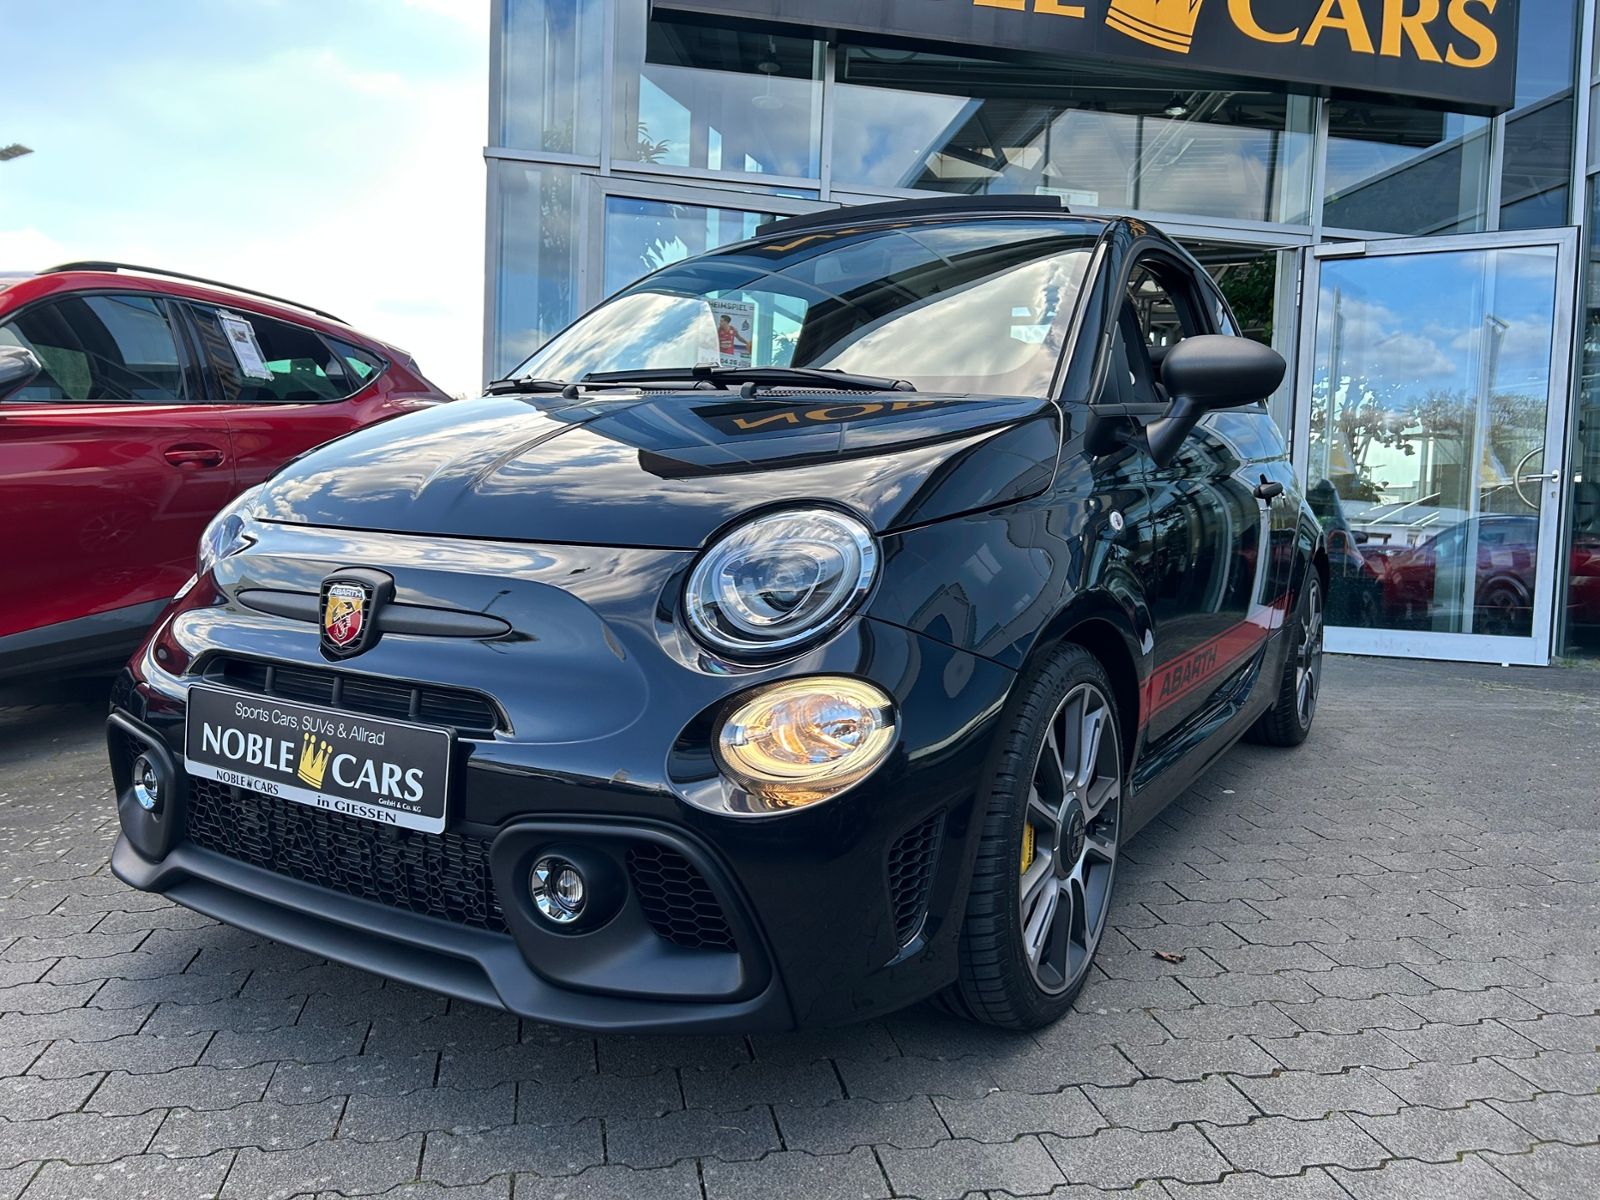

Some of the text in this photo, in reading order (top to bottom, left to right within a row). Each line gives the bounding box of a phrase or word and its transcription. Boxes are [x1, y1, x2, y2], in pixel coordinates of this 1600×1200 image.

[1227, 0, 1498, 68] CARS
[331, 588, 362, 597] ABARTH
[1160, 643, 1218, 698] ABARTH
[235, 701, 385, 746] Sports Cars, SUVs & Allrad
[202, 722, 424, 802] NOBLE CARS
[216, 769, 279, 795] NOBLE CARS
[317, 795, 397, 824] in GIESSEN
[378, 798, 396, 807] GmbH
[402, 803, 412, 811] Co.
[412, 805, 422, 813] KG
